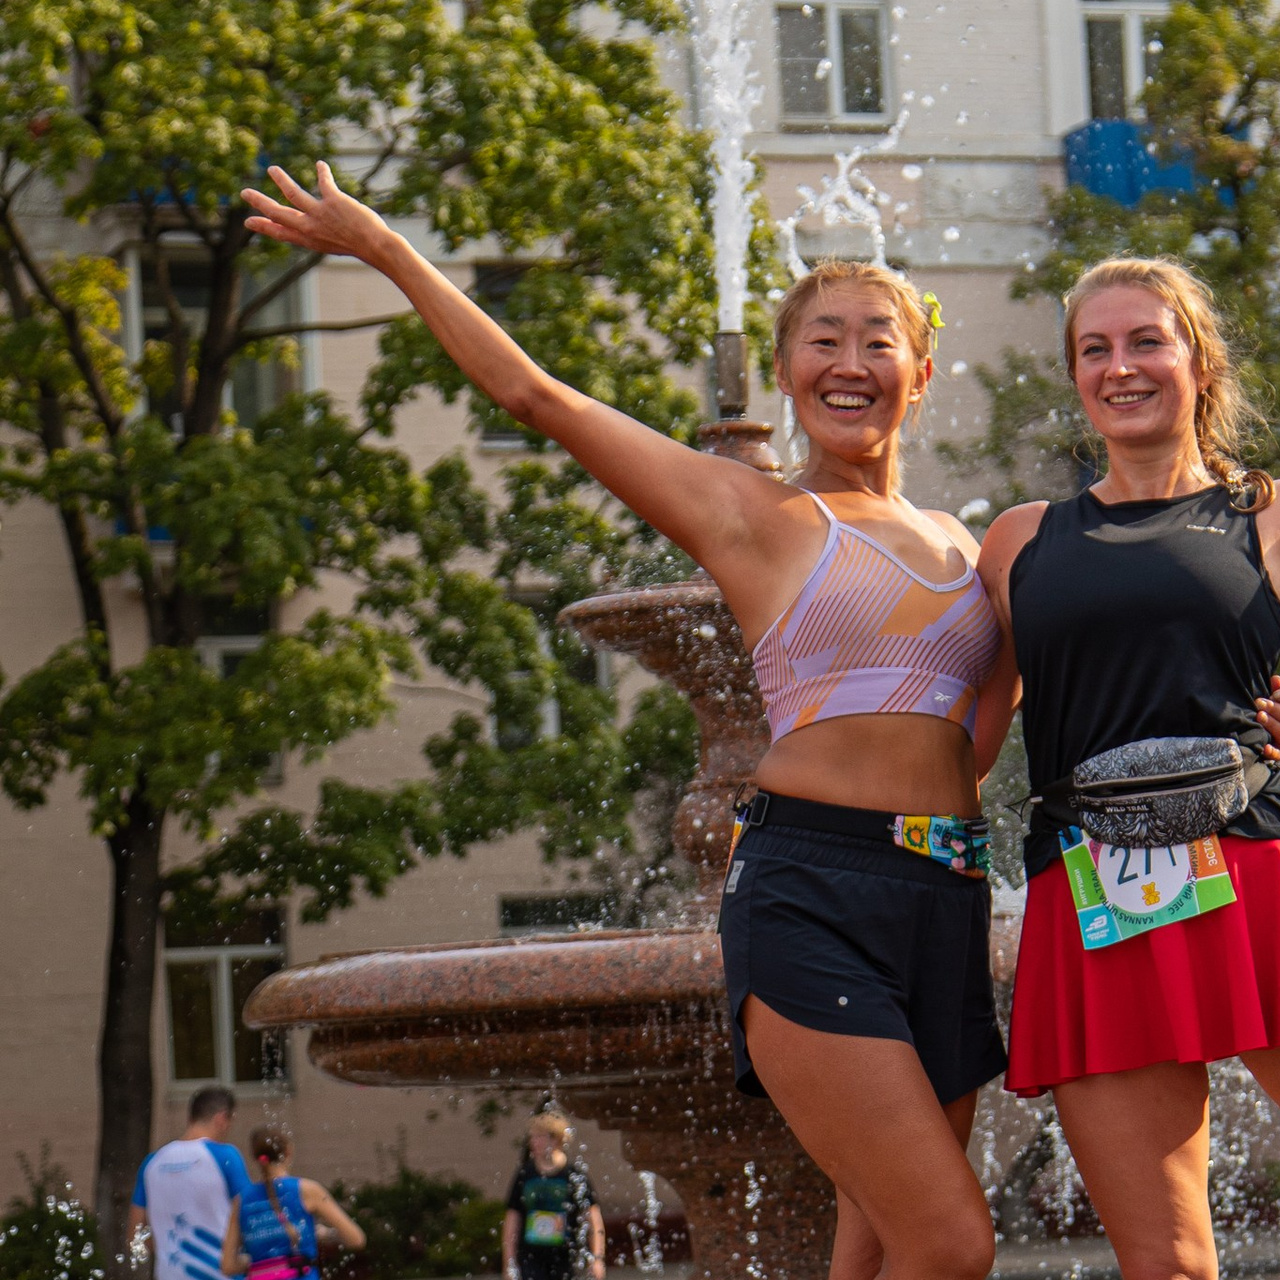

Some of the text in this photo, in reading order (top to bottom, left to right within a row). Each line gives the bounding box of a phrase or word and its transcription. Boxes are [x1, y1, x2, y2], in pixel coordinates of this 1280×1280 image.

[1105, 804, 1150, 813] WILD TRAIL
[1202, 835, 1218, 867] ЭСТА
[1091, 869, 1101, 894] TRAIL
[1168, 899, 1185, 915] ЛЕС
[1119, 912, 1154, 925] KANNAS
